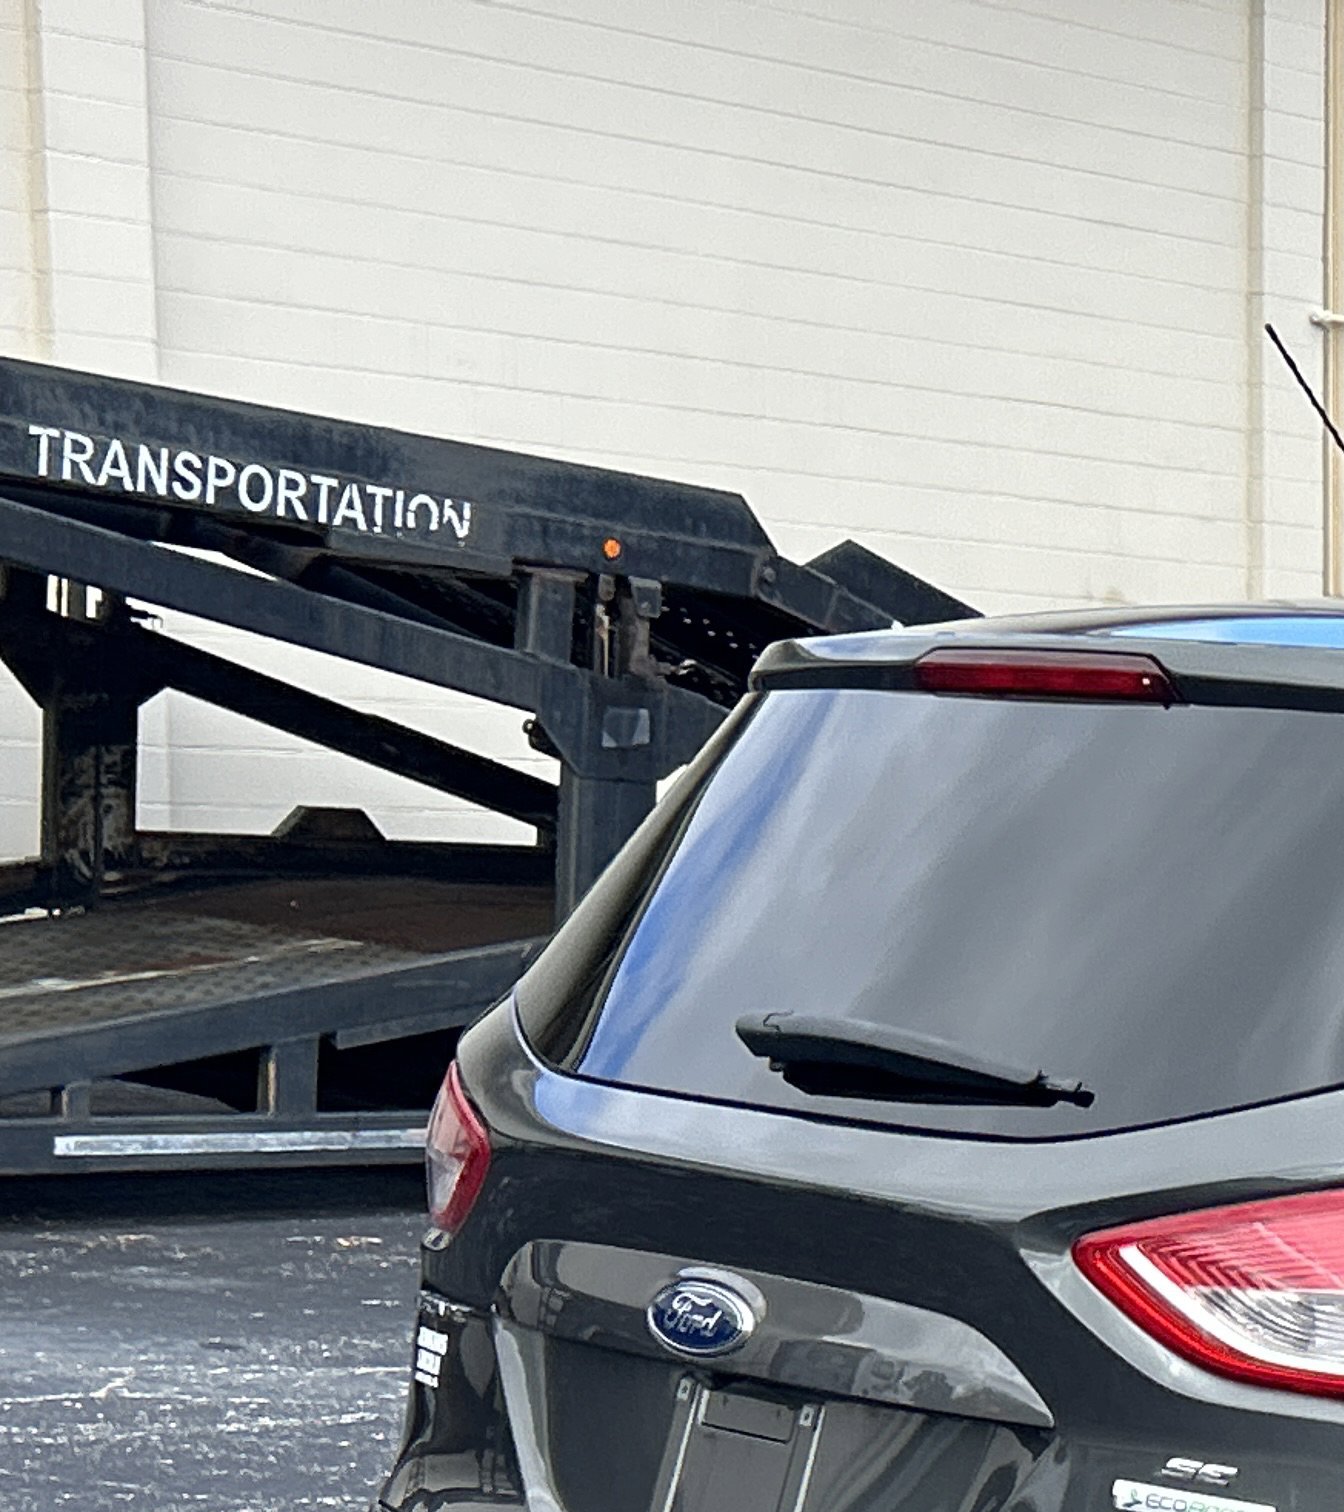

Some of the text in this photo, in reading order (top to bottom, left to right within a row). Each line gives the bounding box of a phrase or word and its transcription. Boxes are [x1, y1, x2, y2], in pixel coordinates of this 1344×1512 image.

[27, 425, 473, 547] TRANSPORTATION
[663, 1291, 723, 1338] Ford
[1160, 1456, 1239, 1487] SE
